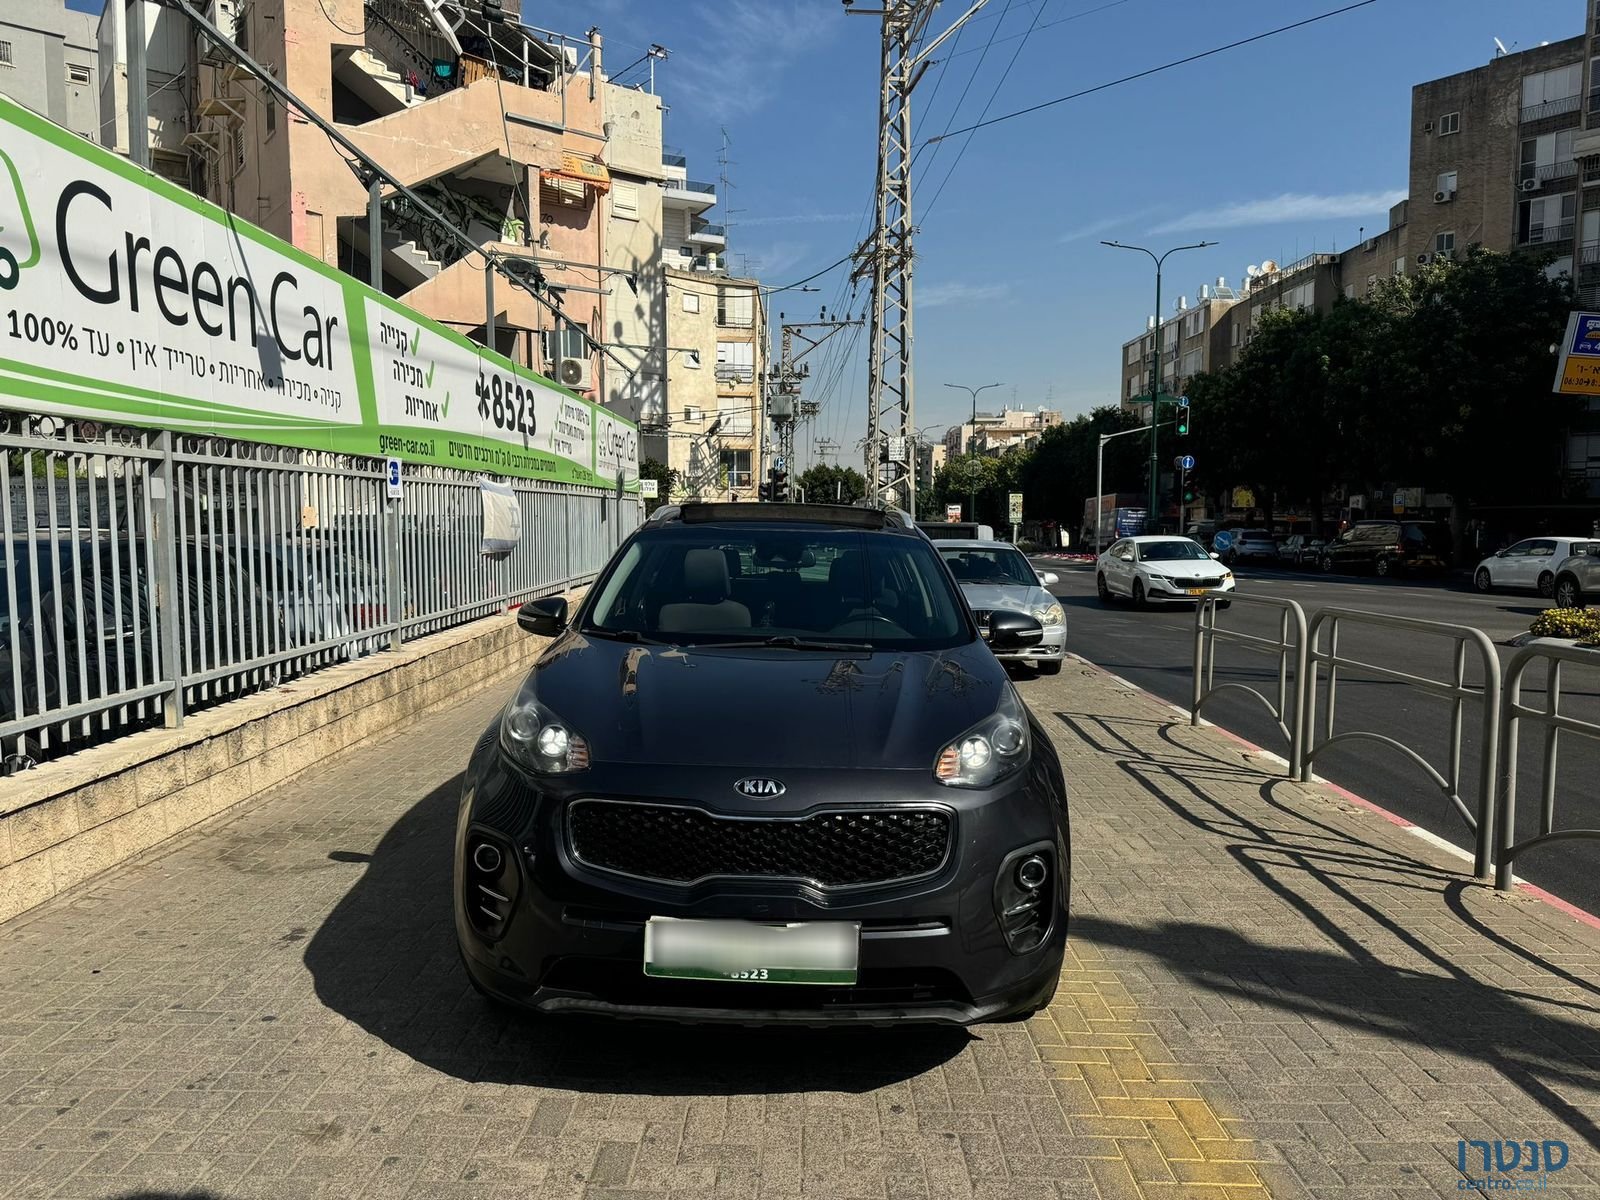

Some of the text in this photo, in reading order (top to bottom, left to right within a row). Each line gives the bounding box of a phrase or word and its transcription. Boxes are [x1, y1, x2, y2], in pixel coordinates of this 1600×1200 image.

[380, 321, 408, 358] קנייה
[7, 309, 342, 413] קניה מכירה אחריות טרייד אין עד 100%
[393, 359, 424, 389] מכירה
[405, 394, 439, 423] אחריות
[379, 434, 436, 456] green-car.co.il
[448, 441, 473, 461] חדשים
[744, 780, 777, 793] KIA
